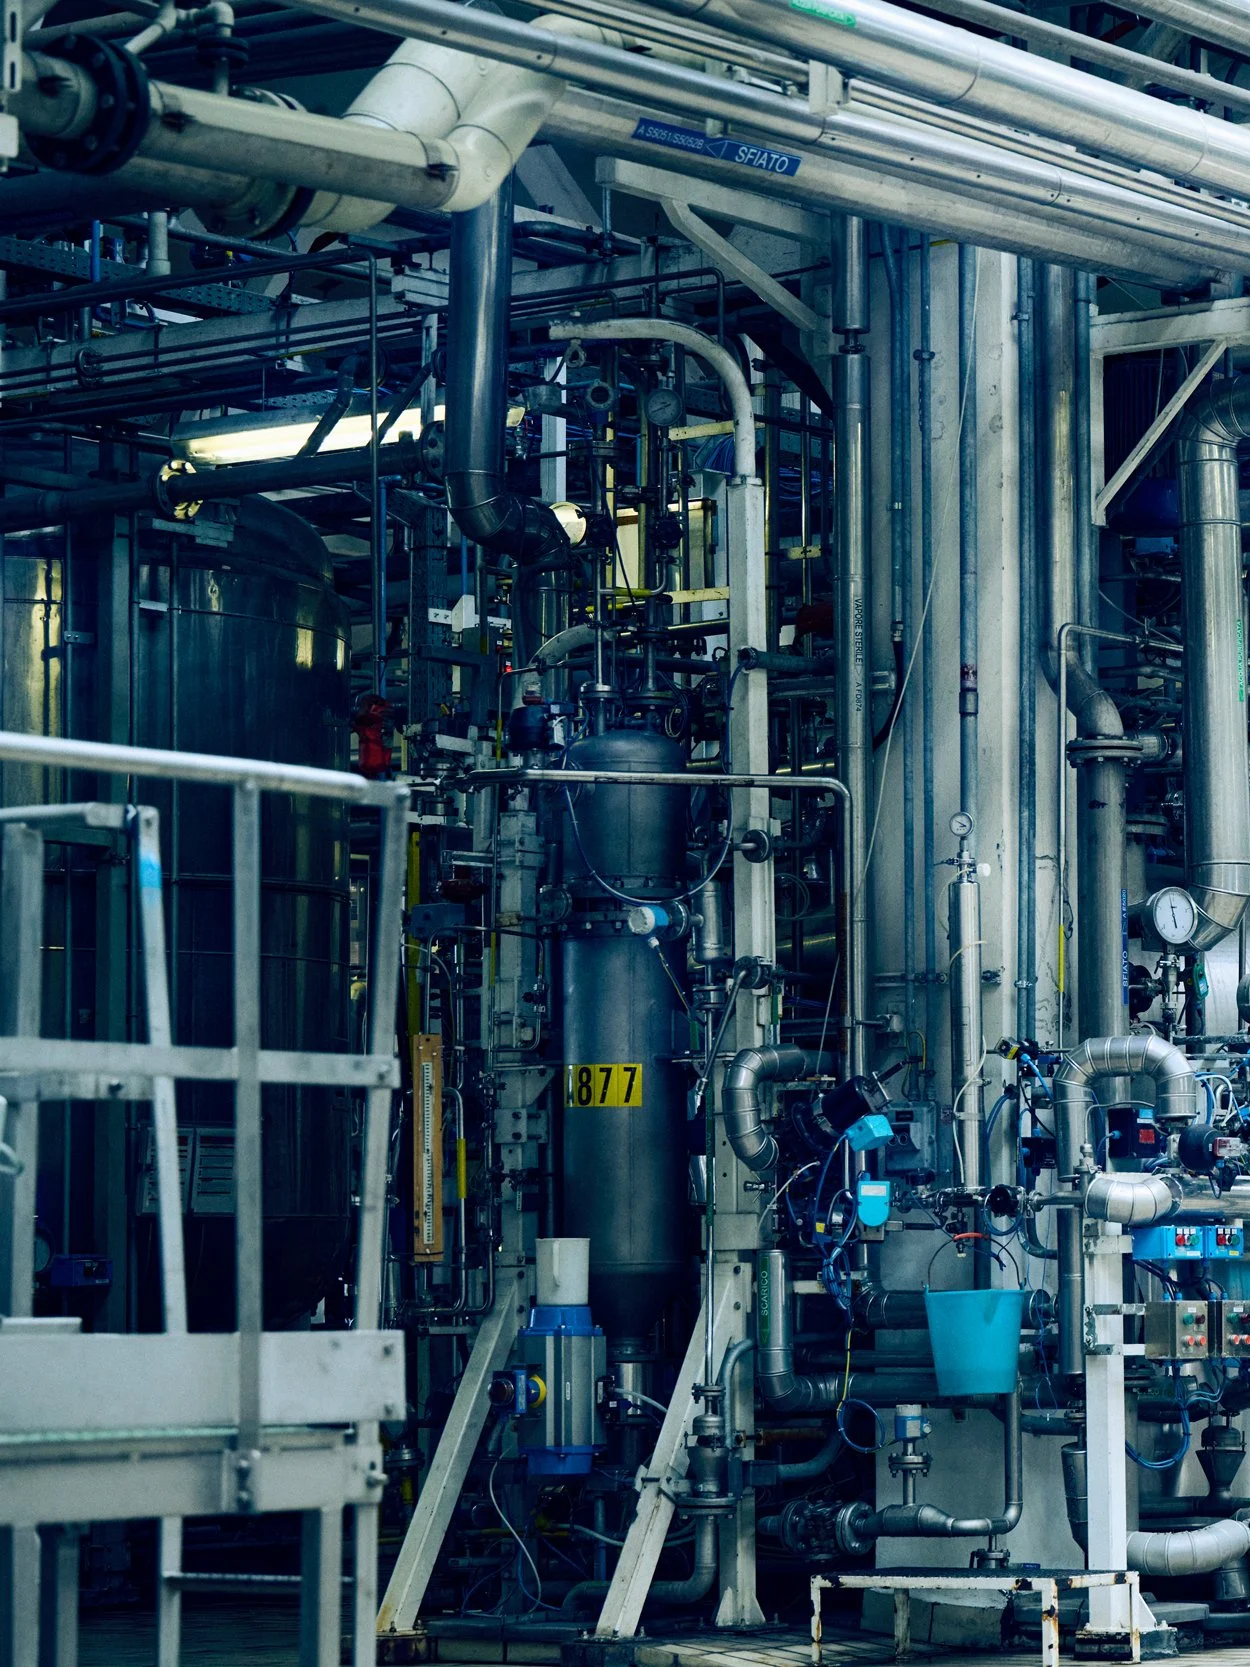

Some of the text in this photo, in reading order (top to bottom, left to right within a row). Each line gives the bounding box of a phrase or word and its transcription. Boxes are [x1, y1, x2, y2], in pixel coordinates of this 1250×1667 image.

[636, 125, 646, 135] A
[735, 146, 789, 173] SFIATO
[854, 598, 862, 629] VAPORE
[854, 631, 863, 663] STERILE
[760, 1270, 769, 1317] SCARICO
